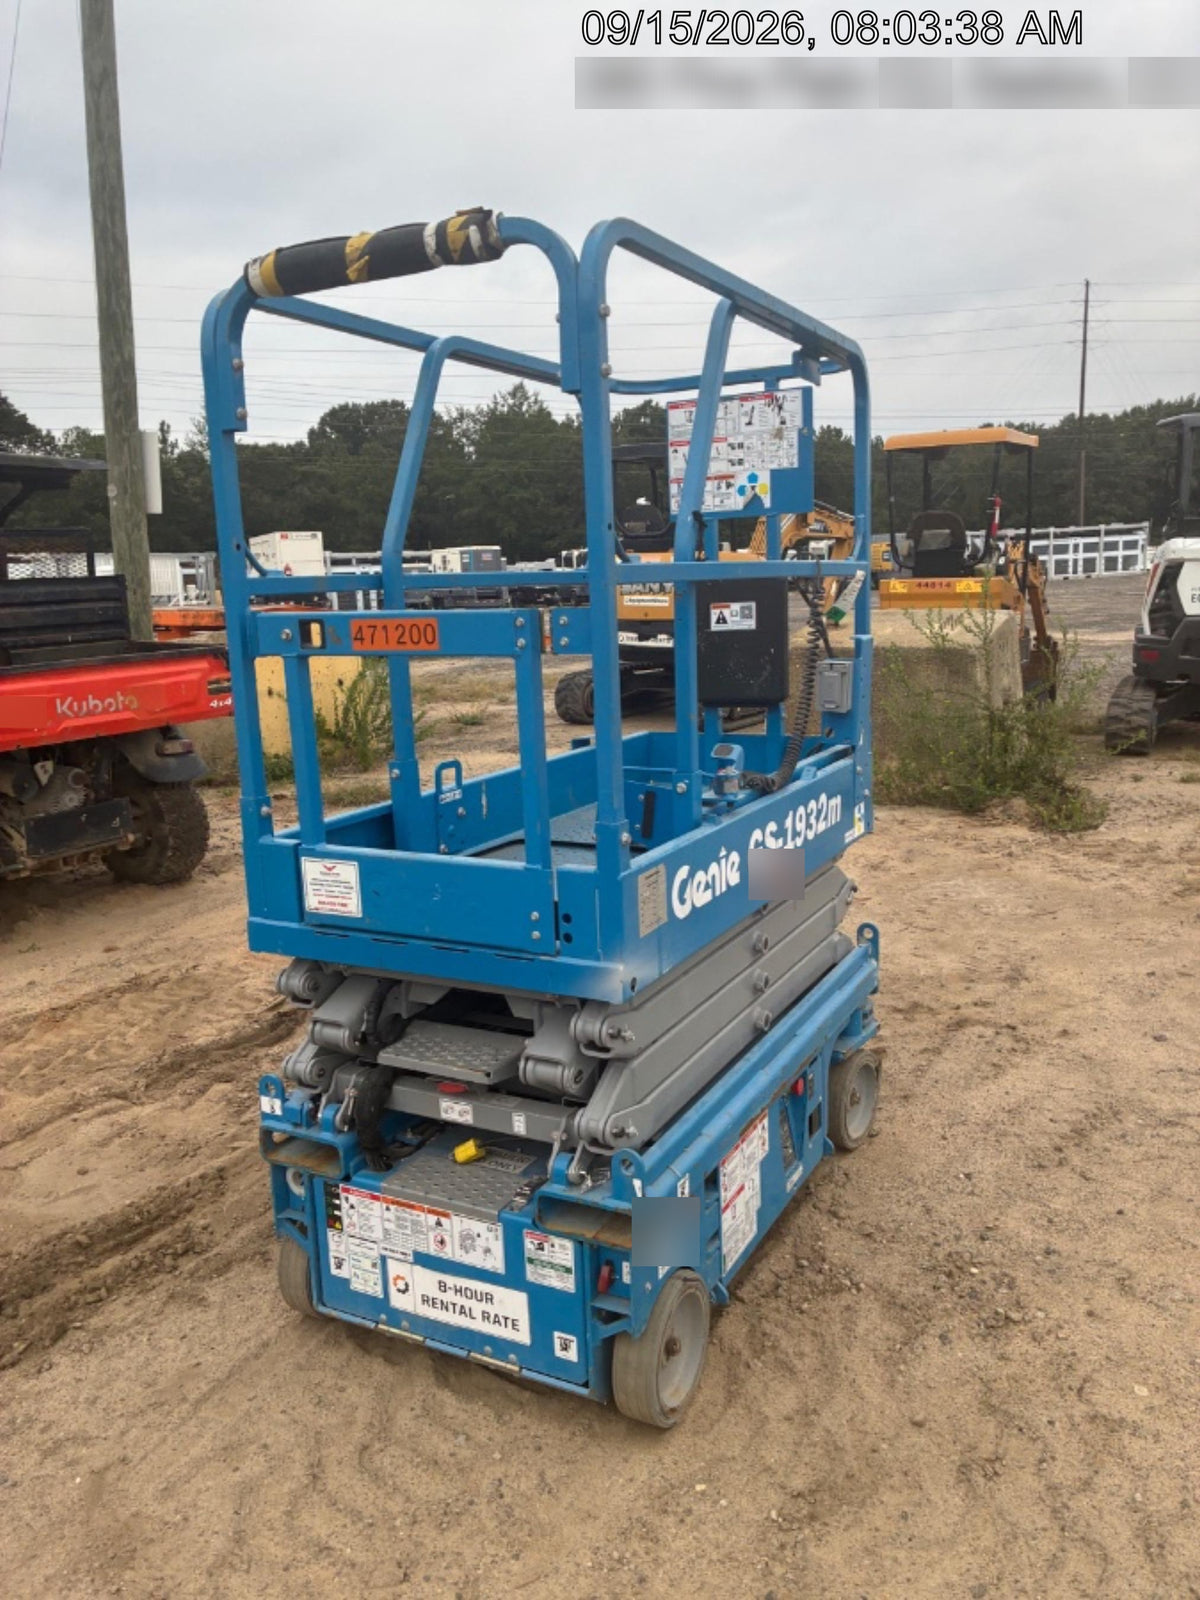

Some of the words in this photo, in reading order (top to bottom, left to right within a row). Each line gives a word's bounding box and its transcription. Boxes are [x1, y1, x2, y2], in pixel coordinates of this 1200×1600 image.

[353, 623, 437, 646] 471200
[56, 691, 140, 718] Kubota
[671, 846, 741, 921] Genie
[438, 1280, 495, 1306] 8-HOUR
[420, 1293, 477, 1320] RENTAL
[481, 1310, 521, 1333] RATE
